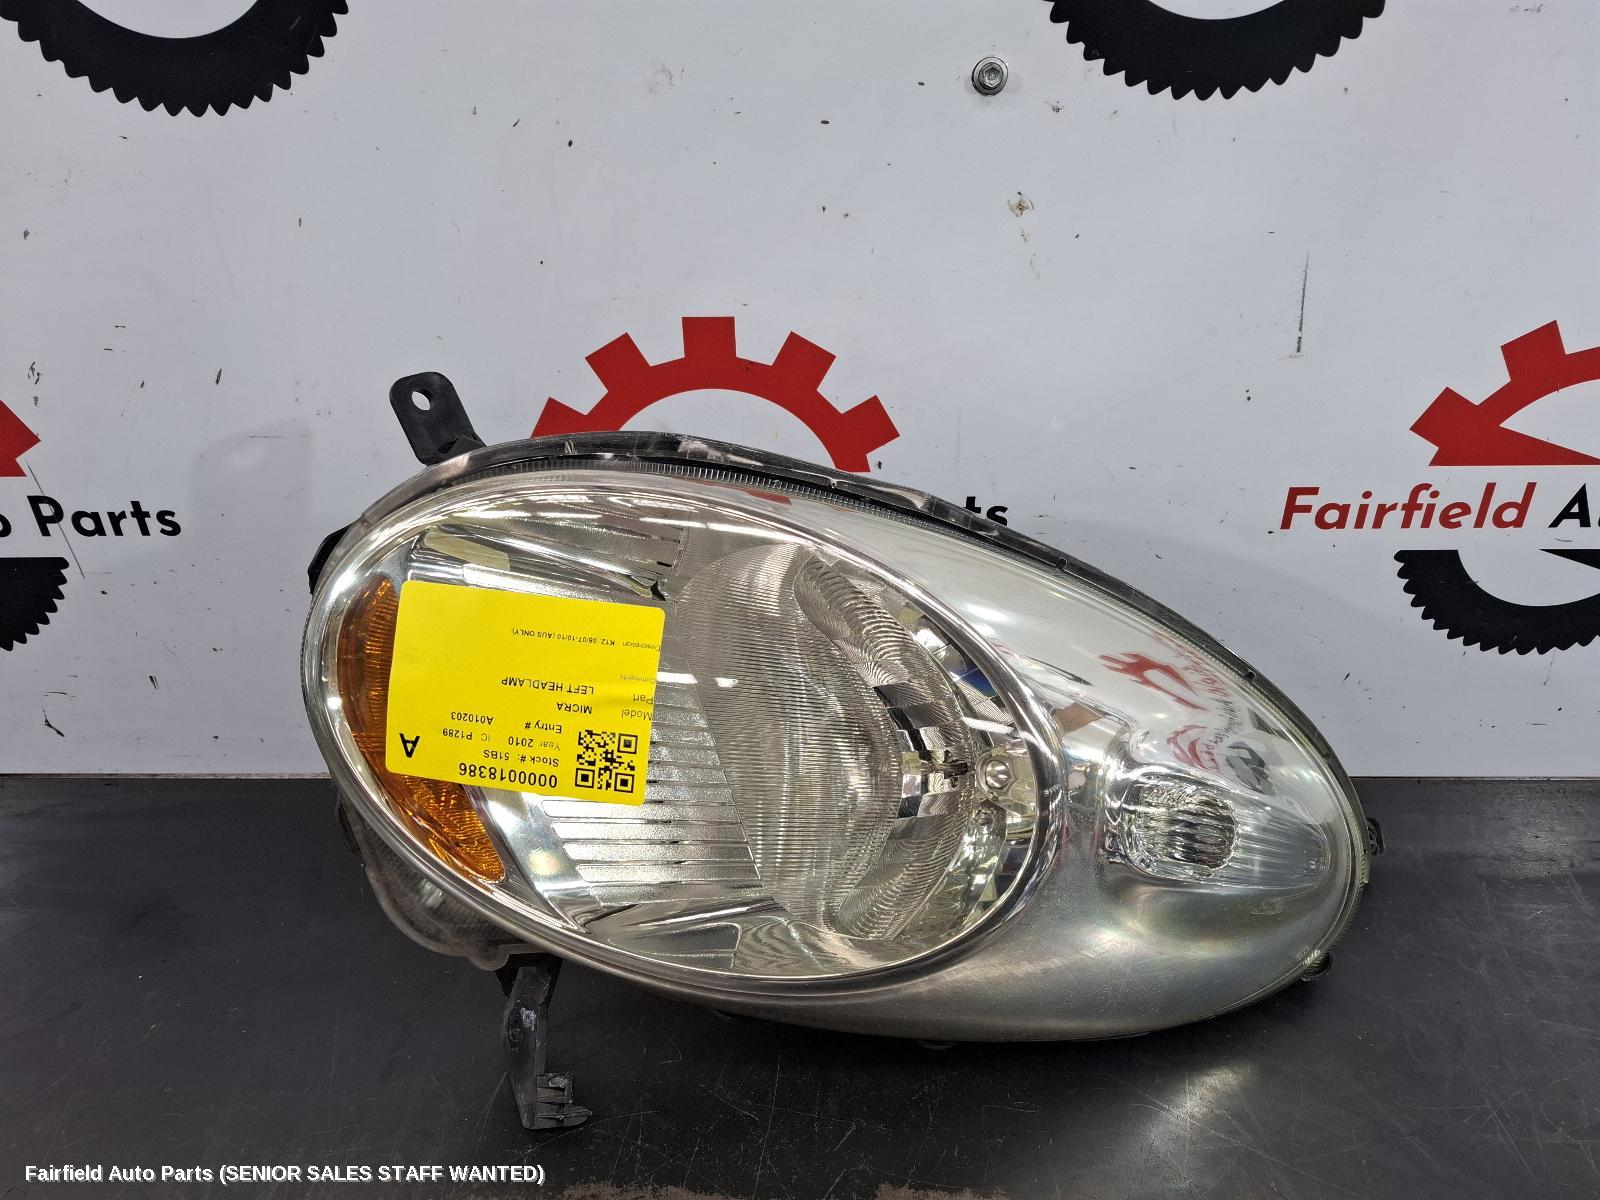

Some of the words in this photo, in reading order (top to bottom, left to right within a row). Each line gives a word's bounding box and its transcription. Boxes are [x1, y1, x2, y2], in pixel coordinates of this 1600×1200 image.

[1280, 482, 1537, 530] Fairfield
[27, 495, 182, 537] Parts
[501, 676, 563, 692] HEADLAMP
[566, 685, 594, 695] LEFT
[633, 694, 653, 704] Part
[556, 702, 593, 714] MICRA
[451, 711, 494, 725] A010203
[621, 709, 653, 720] Model
[524, 721, 531, 730] #
[534, 719, 563, 733] Entry
[443, 728, 473, 740] P1289
[399, 733, 420, 758] A
[508, 736, 533, 747] 2010
[539, 741, 561, 751] Year
[483, 749, 510, 760] 51BS
[530, 756, 559, 766] Stock
[459, 763, 558, 788] 0000018386
